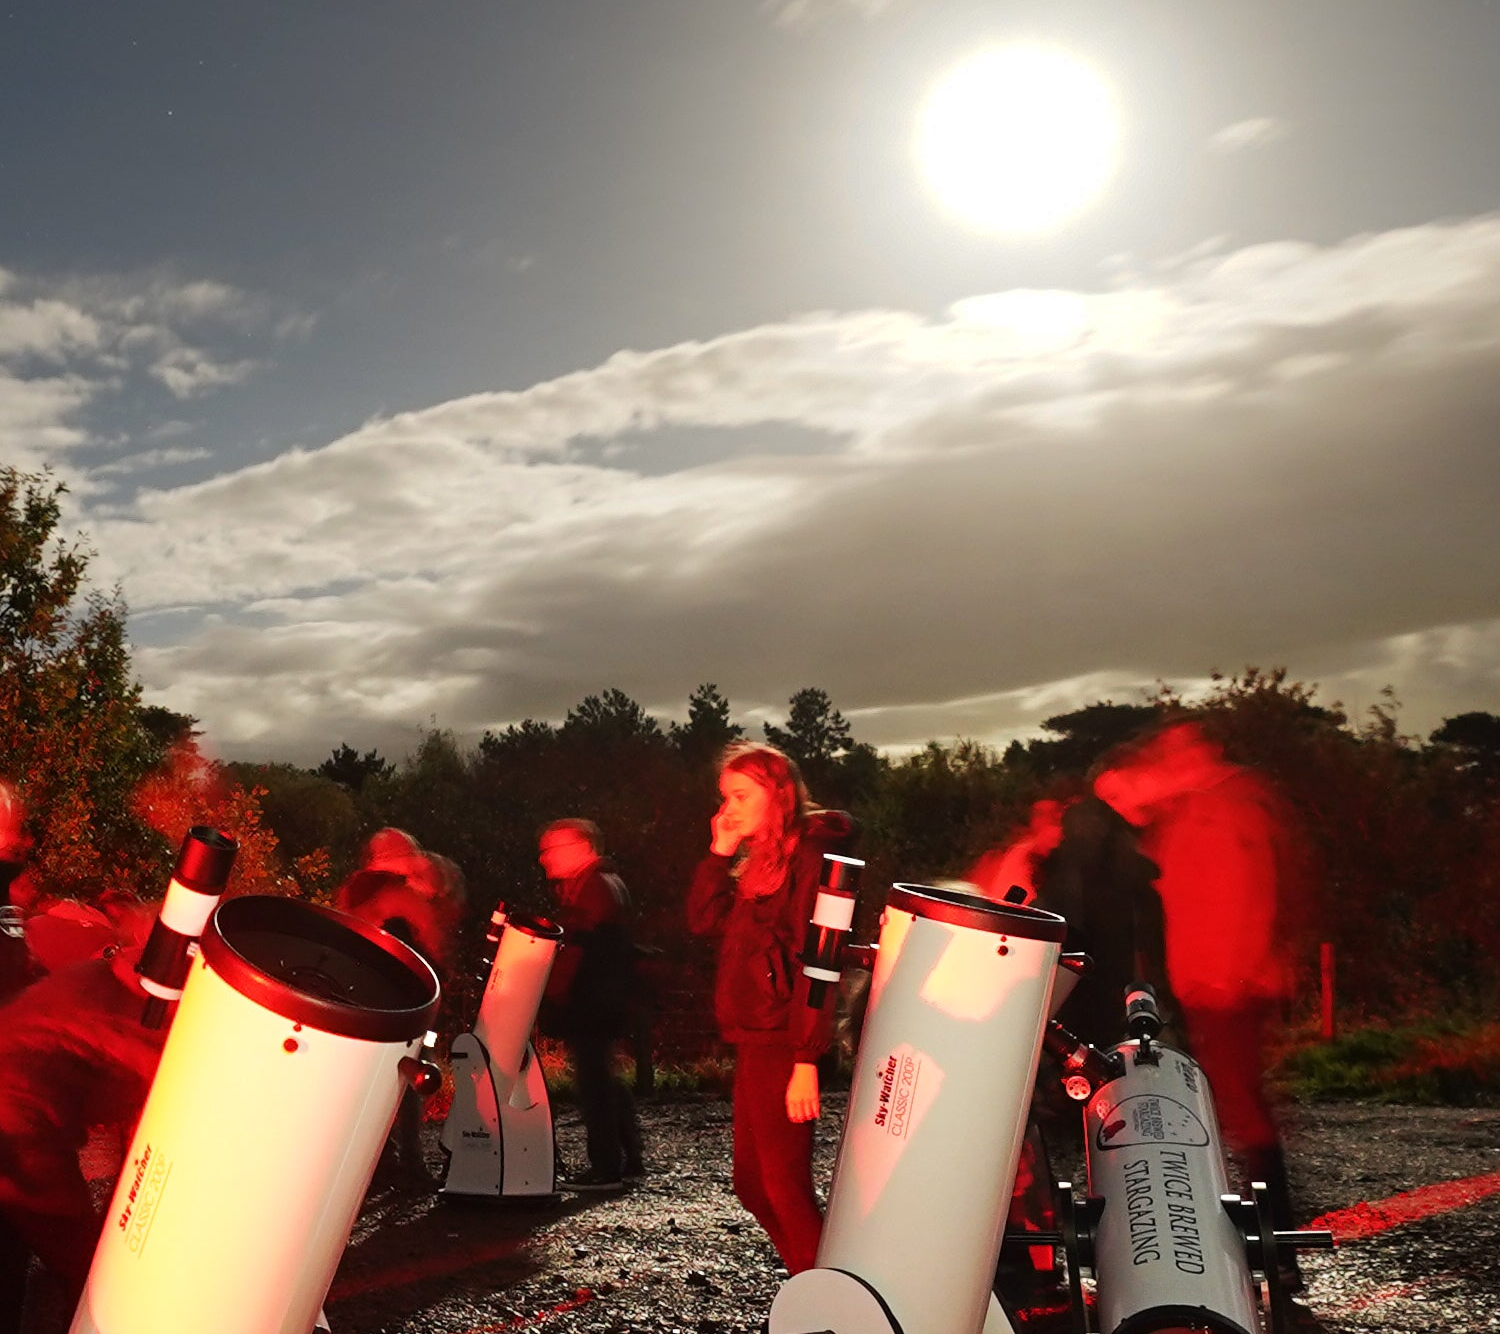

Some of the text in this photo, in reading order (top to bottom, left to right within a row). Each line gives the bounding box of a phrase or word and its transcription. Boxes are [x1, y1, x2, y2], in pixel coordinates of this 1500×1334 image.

[874, 1055, 898, 1127] Sky-Watcher
[891, 1056, 915, 1137] CLASSIC 200P
[119, 1143, 152, 1232] Sky-Watcher
[1123, 1159, 1161, 1266] STARGAZING
[1160, 1151, 1205, 1275] TWICE BREWED
